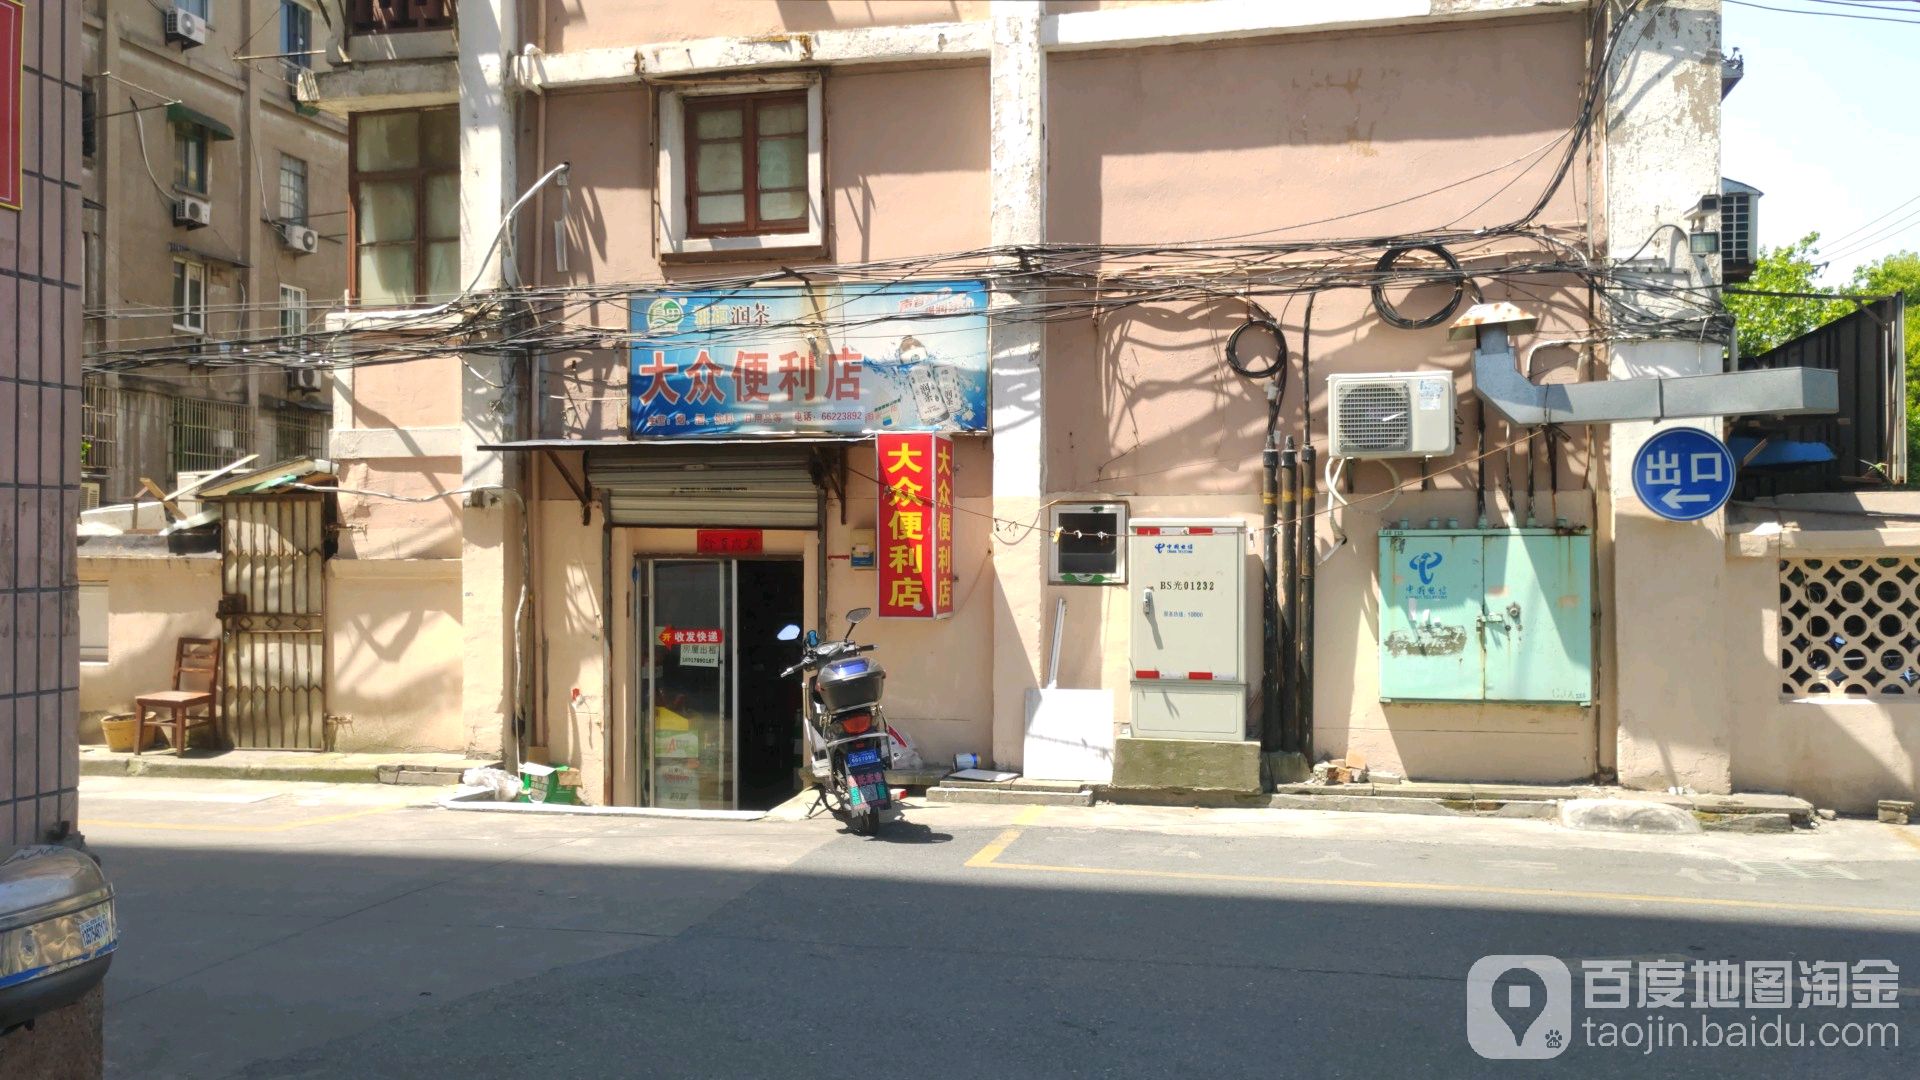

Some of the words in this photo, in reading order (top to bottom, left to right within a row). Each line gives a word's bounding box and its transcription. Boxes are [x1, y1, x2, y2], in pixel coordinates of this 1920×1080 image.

[638, 346, 864, 406] 大众便利店
[1645, 450, 1723, 486] 出口
[887, 443, 923, 607] 大众便利店
[937, 446, 950, 607] 大众便利店
[1160, 581, 1215, 591] BS光01232
[674, 631, 719, 642] 收发快递
